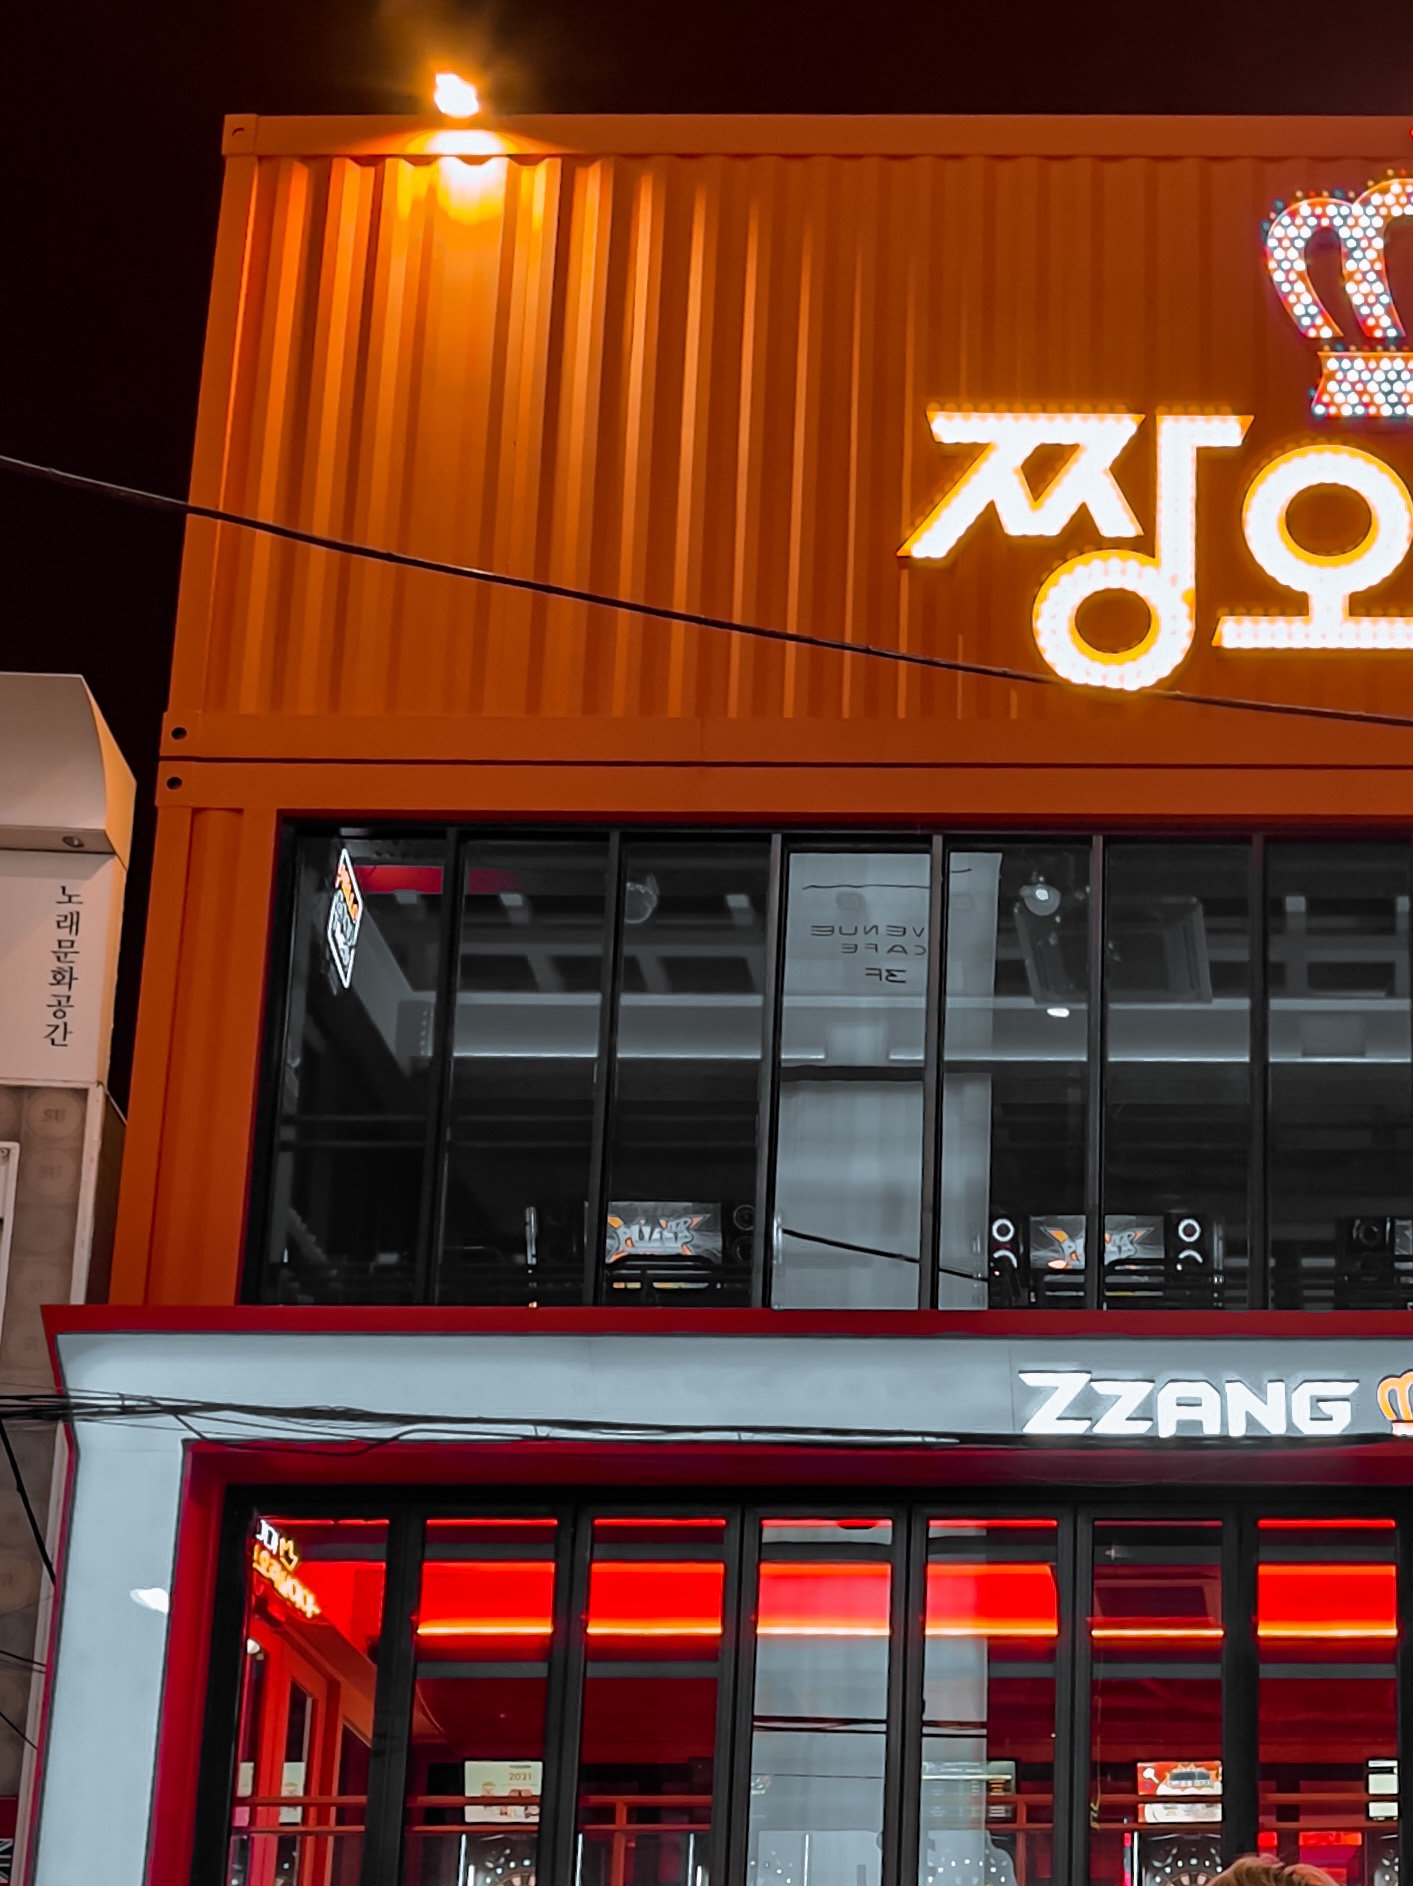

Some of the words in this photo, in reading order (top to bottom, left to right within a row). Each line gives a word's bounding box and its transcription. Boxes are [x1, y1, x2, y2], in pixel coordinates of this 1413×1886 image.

[43, 884, 84, 1048] 노래문화공간
[1018, 1369, 1360, 1438] ZZANG
[508, 1772, 532, 1782] 2021
